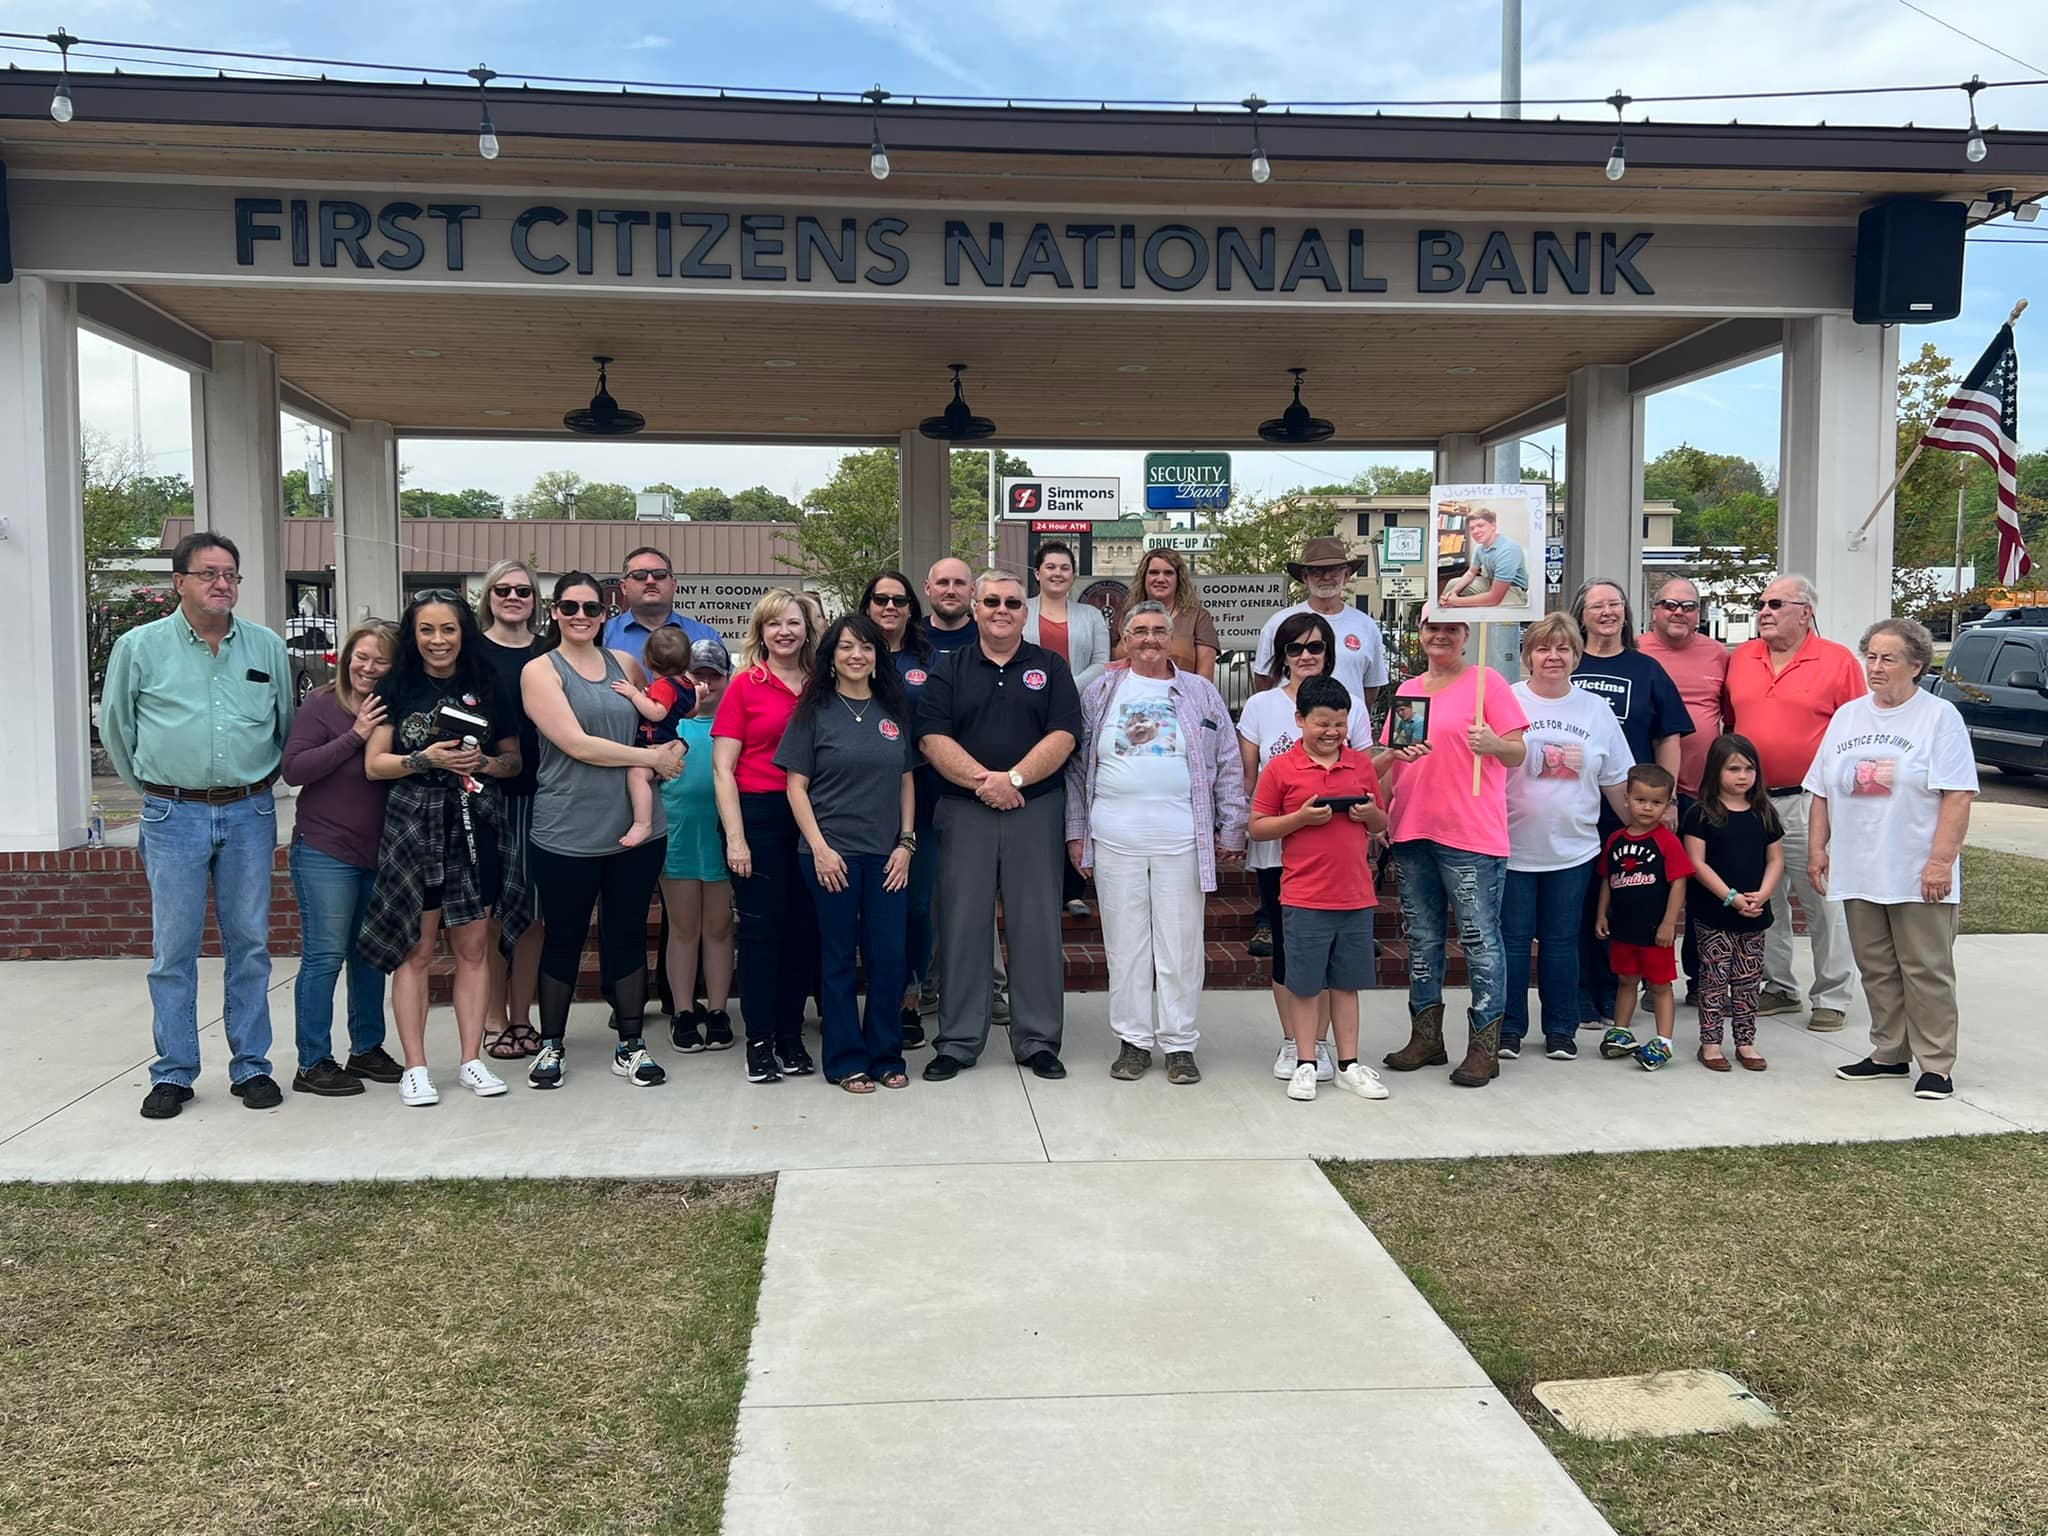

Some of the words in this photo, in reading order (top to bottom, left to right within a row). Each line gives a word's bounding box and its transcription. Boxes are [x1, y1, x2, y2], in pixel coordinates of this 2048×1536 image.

[235, 198, 480, 271] FIRST
[511, 206, 910, 286] CITIZENS
[944, 220, 1387, 294] NATIONAL
[1417, 229, 1655, 295] BANK
[1150, 466, 1222, 482] SECURITY
[1048, 486, 1114, 499] Simmons
[1175, 480, 1225, 498] Bank
[1048, 500, 1083, 511] Bank
[1149, 538, 1198, 549] DRIVE-UP
[715, 586, 773, 595] GOODMA
[1203, 585, 1264, 594] GOODMAN
[1268, 584, 1279, 593] JR
[699, 601, 752, 610] ATTORNEY
[1203, 600, 1237, 608] ORNEY
[1240, 600, 1285, 608] GENERAL
[695, 615, 734, 625] Victims
[737, 615, 751, 625] Fir
[1223, 613, 1245, 622] First
[1547, 719, 1562, 730] FOR
[1564, 723, 1590, 740] JIMMY
[1837, 735, 1873, 754] JUSTICE
[1873, 734, 1890, 744] FOR
